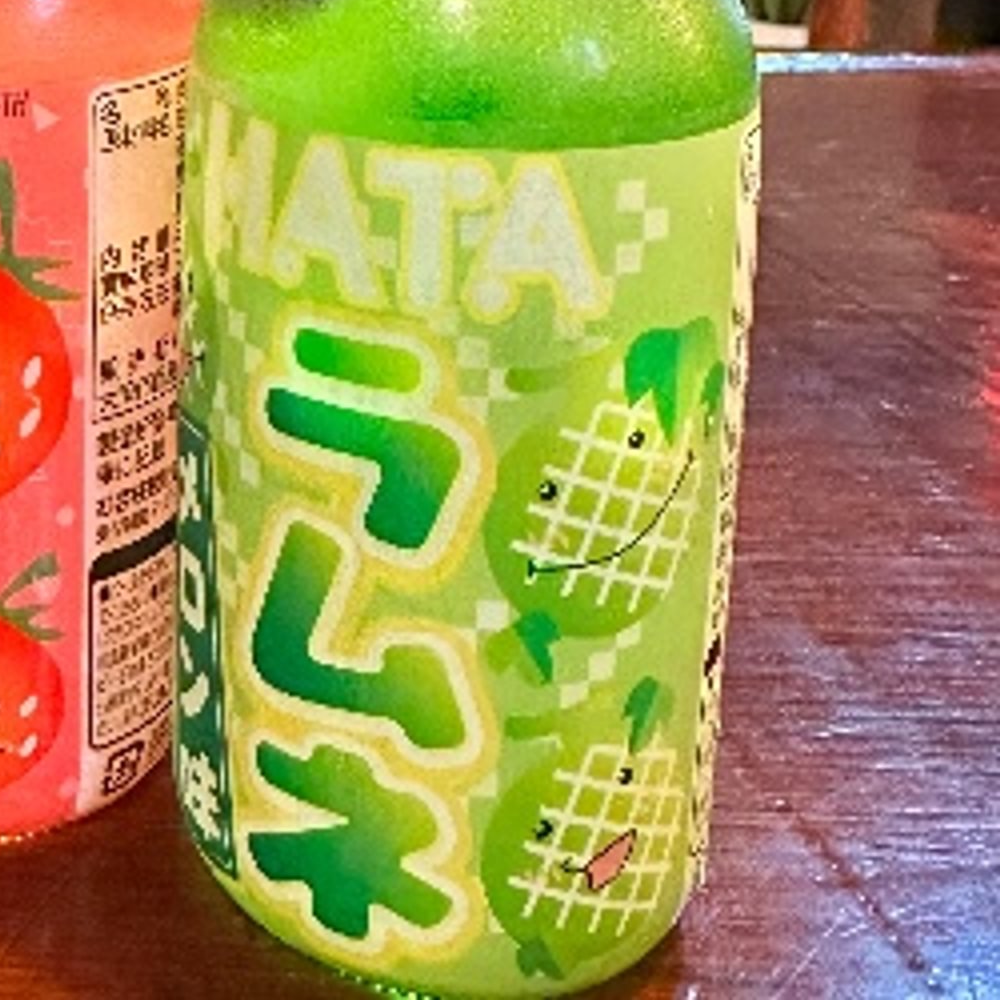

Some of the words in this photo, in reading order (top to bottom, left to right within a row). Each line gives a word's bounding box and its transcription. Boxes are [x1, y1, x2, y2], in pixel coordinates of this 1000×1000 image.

[205, 100, 612, 322] HATA
[245, 315, 484, 952] ラムネ
